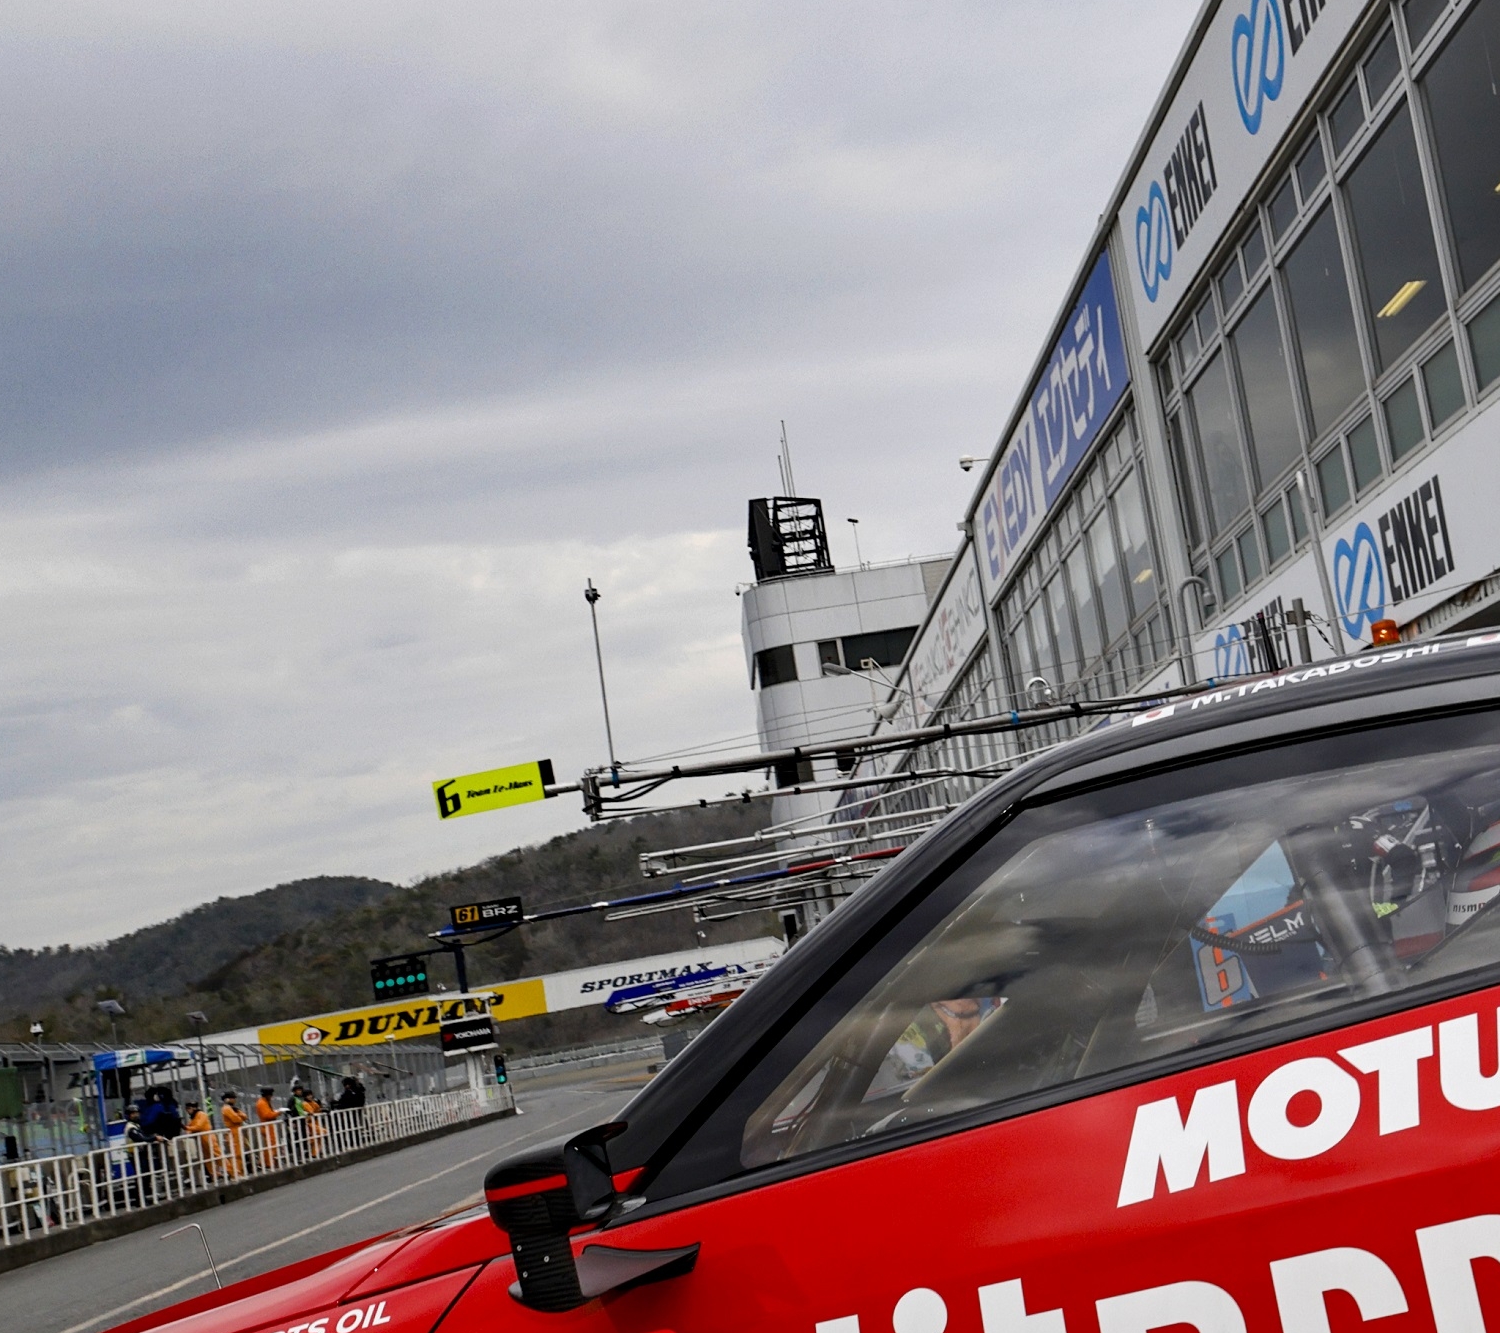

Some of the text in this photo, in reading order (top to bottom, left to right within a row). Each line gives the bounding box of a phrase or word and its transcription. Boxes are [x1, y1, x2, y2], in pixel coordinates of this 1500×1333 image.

[1163, 100, 1218, 250] ENKEI
[983, 421, 1037, 581] EXEDY
[1378, 475, 1455, 600] ENKEI
[437, 779, 461, 819] 6
[457, 907, 479, 923] 61
[482, 905, 518, 918] BRZ
[580, 962, 713, 993] SPORTMAX
[454, 1028, 492, 1040] YOKOHAMA
